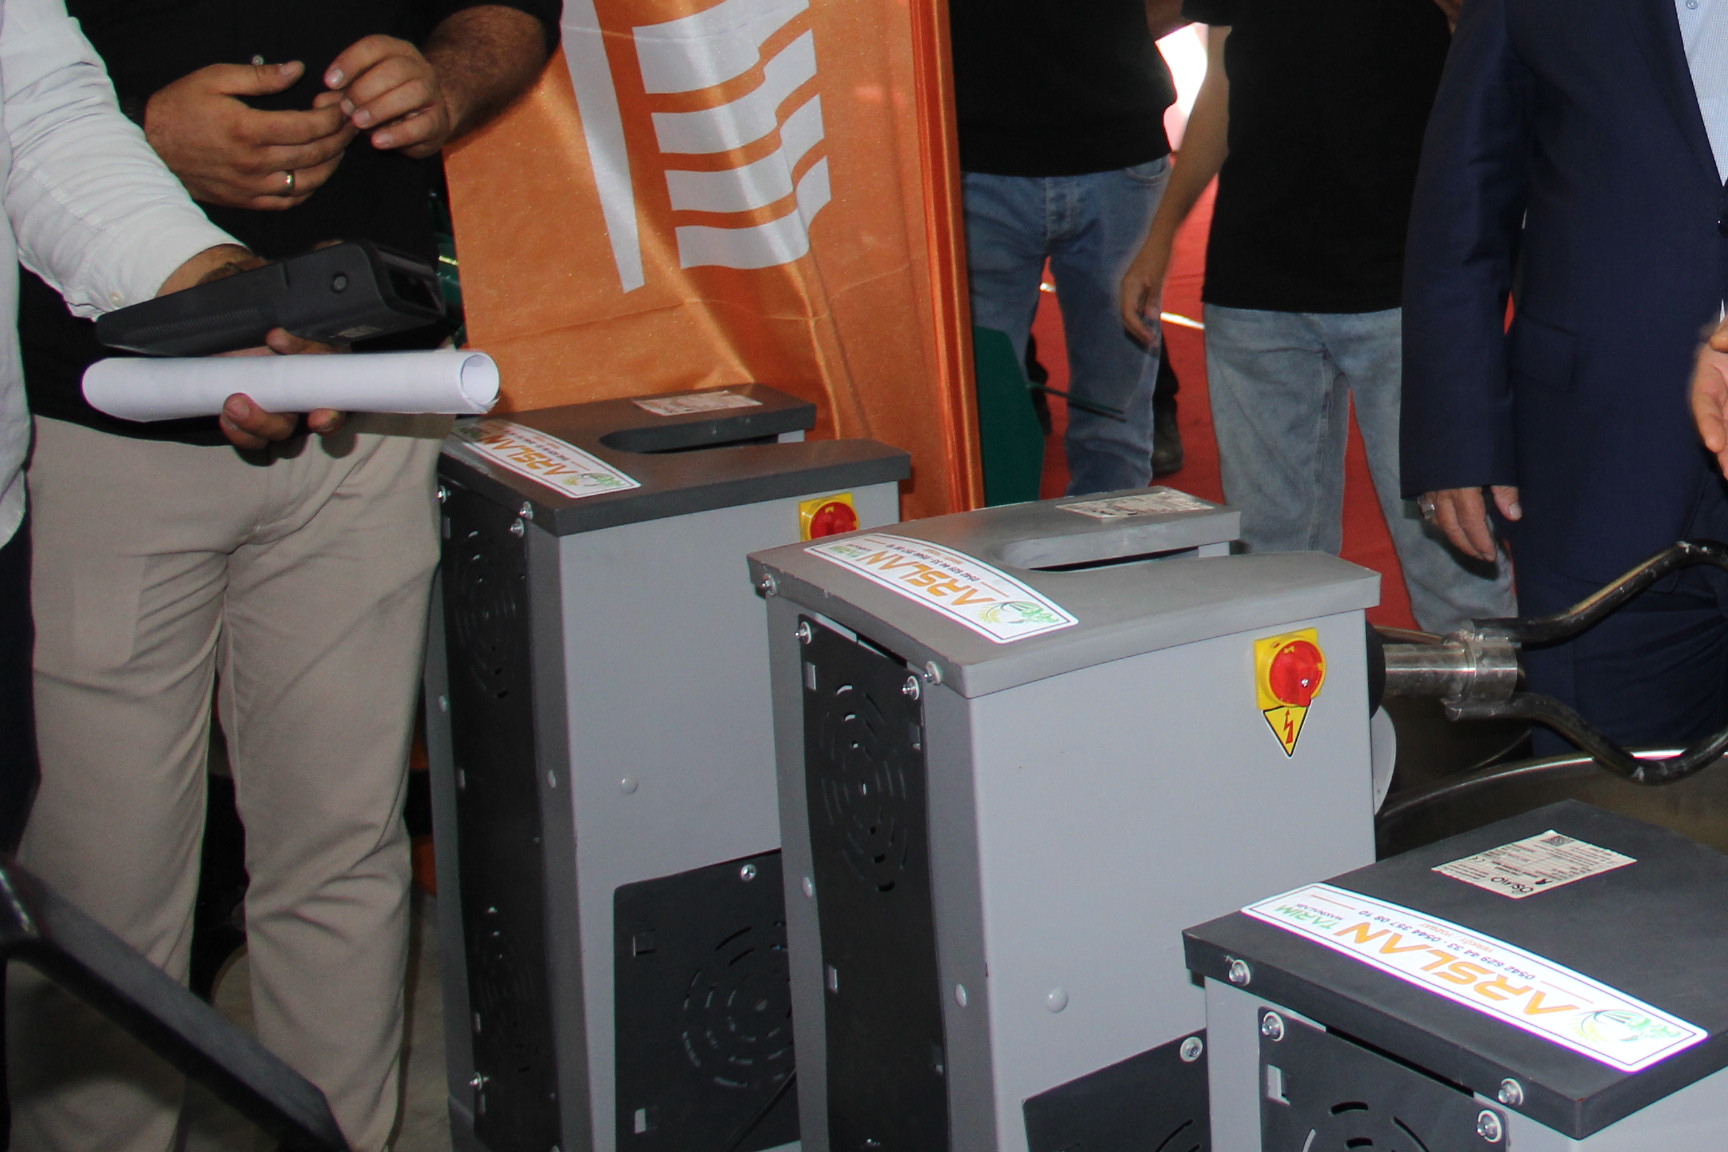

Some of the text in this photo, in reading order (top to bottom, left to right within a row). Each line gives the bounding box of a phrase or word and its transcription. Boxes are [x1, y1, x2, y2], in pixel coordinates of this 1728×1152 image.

[477, 433, 579, 476] ARSLAN
[855, 550, 997, 607] ARSLAN
[1273, 904, 1340, 929] TARIM
[1358, 910, 1372, 918] 10
[1373, 915, 1391, 923] 08
[1390, 920, 1413, 931] 357
[1412, 929, 1442, 942] 0544
[1447, 942, 1465, 951] 33
[1464, 949, 1481, 957] 44
[1332, 921, 1581, 1015] ARSLAN
[1481, 955, 1505, 968] 629
[1504, 965, 1536, 980] 0542
